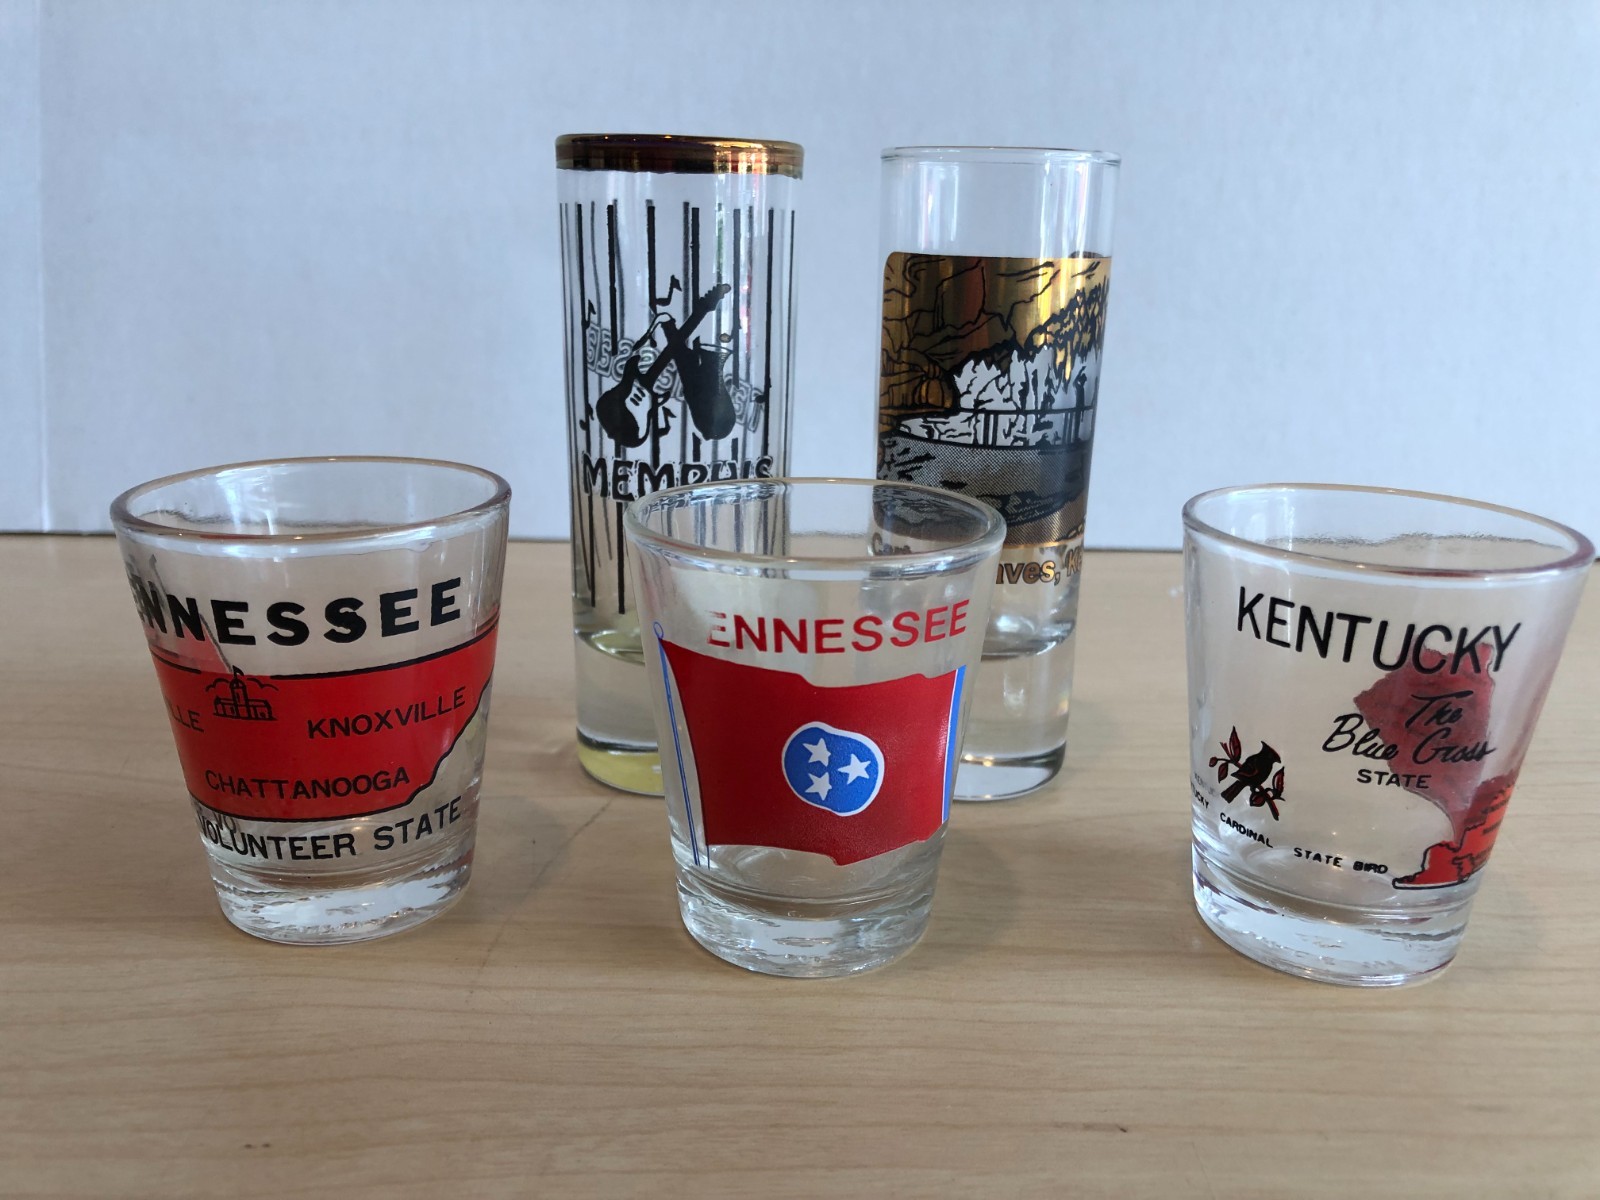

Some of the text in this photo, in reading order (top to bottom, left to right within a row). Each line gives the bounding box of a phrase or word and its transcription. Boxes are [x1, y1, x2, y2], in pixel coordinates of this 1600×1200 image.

[129, 577, 462, 647] NNESSEE
[1237, 586, 1522, 675] KENTUCKY
[307, 686, 467, 739] KNOXVILLE
[1404, 690, 1474, 728] The
[1321, 713, 1497, 764] Blue Grass
[204, 766, 410, 800] CHATTANOOGA
[1356, 768, 1432, 790] STATE
[199, 814, 356, 860] VOLUNTEER
[372, 796, 462, 851] STATE
[1219, 812, 1274, 849] CARDINAL
[1293, 846, 1343, 868] STATE
[1352, 860, 1389, 875] BIRD
